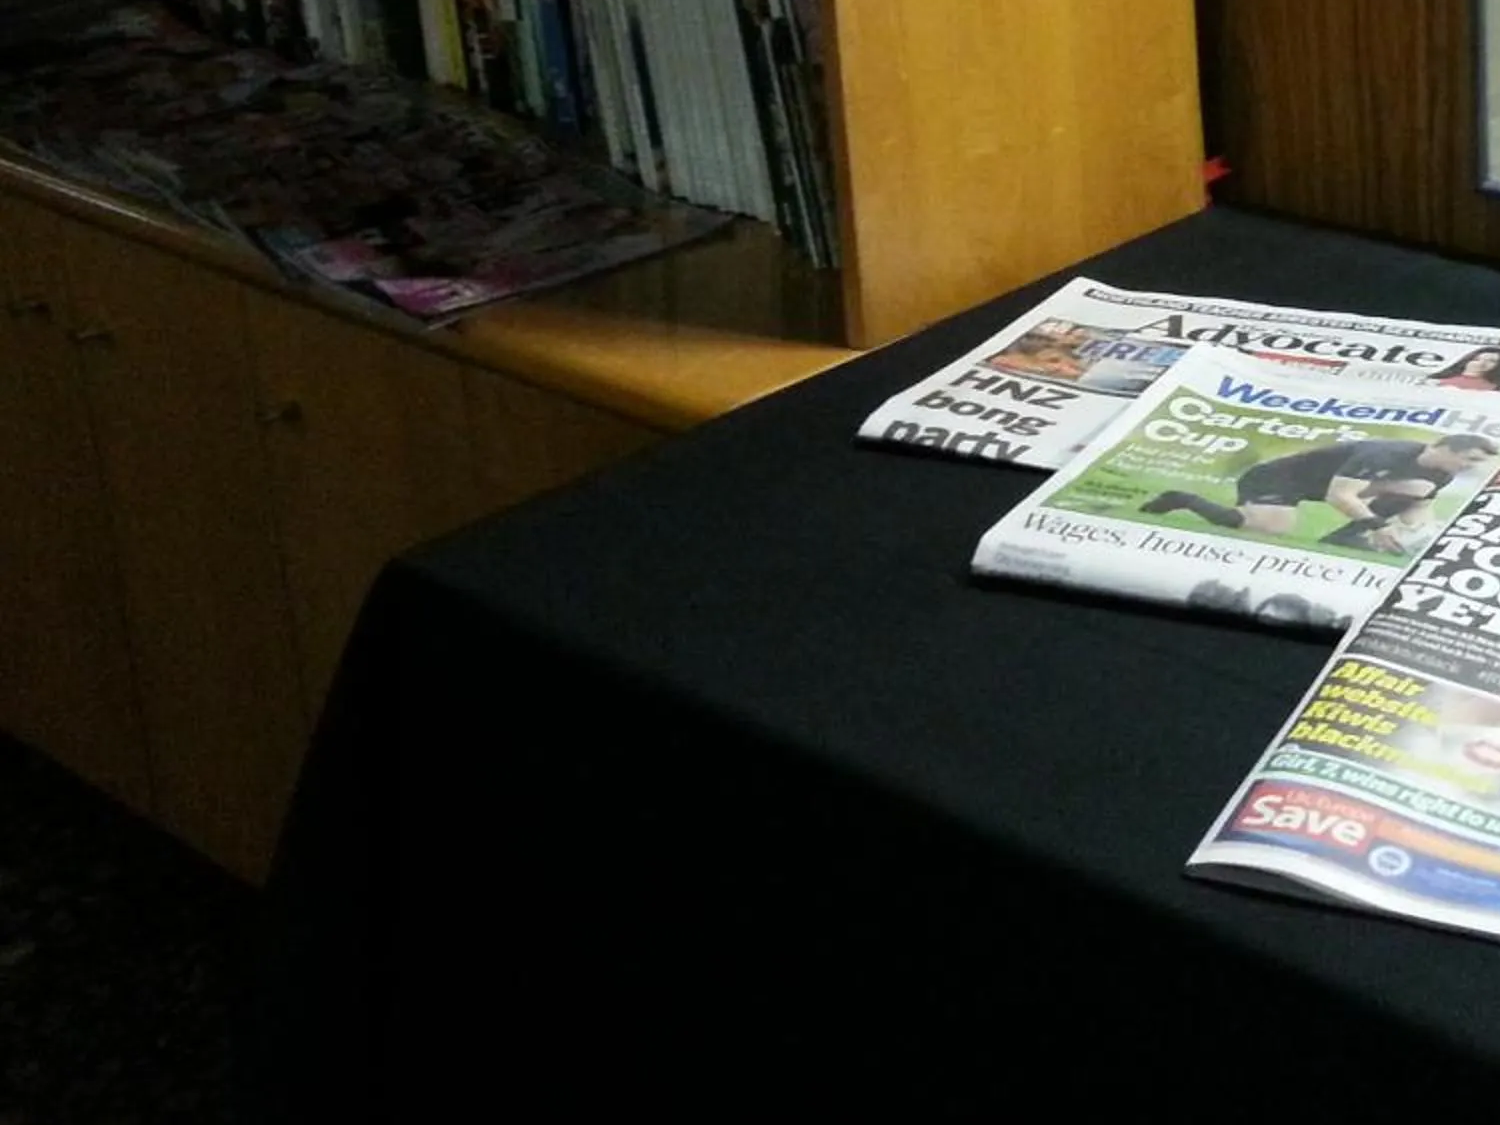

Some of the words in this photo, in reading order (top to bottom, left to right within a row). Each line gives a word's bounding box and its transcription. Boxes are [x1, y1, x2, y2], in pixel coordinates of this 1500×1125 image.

[1128, 314, 1446, 368] Advocate
[950, 370, 1080, 410] HNZ
[913, 389, 1057, 437] bong
[1169, 396, 1369, 443] Carter's
[881, 420, 1031, 461] party
[1145, 419, 1248, 453] Cup
[1023, 511, 1128, 546] Wages,
[1332, 661, 1425, 697] Affair
[1301, 700, 1398, 735] Kiwis
[1319, 684, 1438, 723] website
[1342, 768, 1399, 796] wins
[1399, 787, 1459, 819] right
[1461, 808, 1486, 828] to
[1242, 795, 1366, 846] Save
